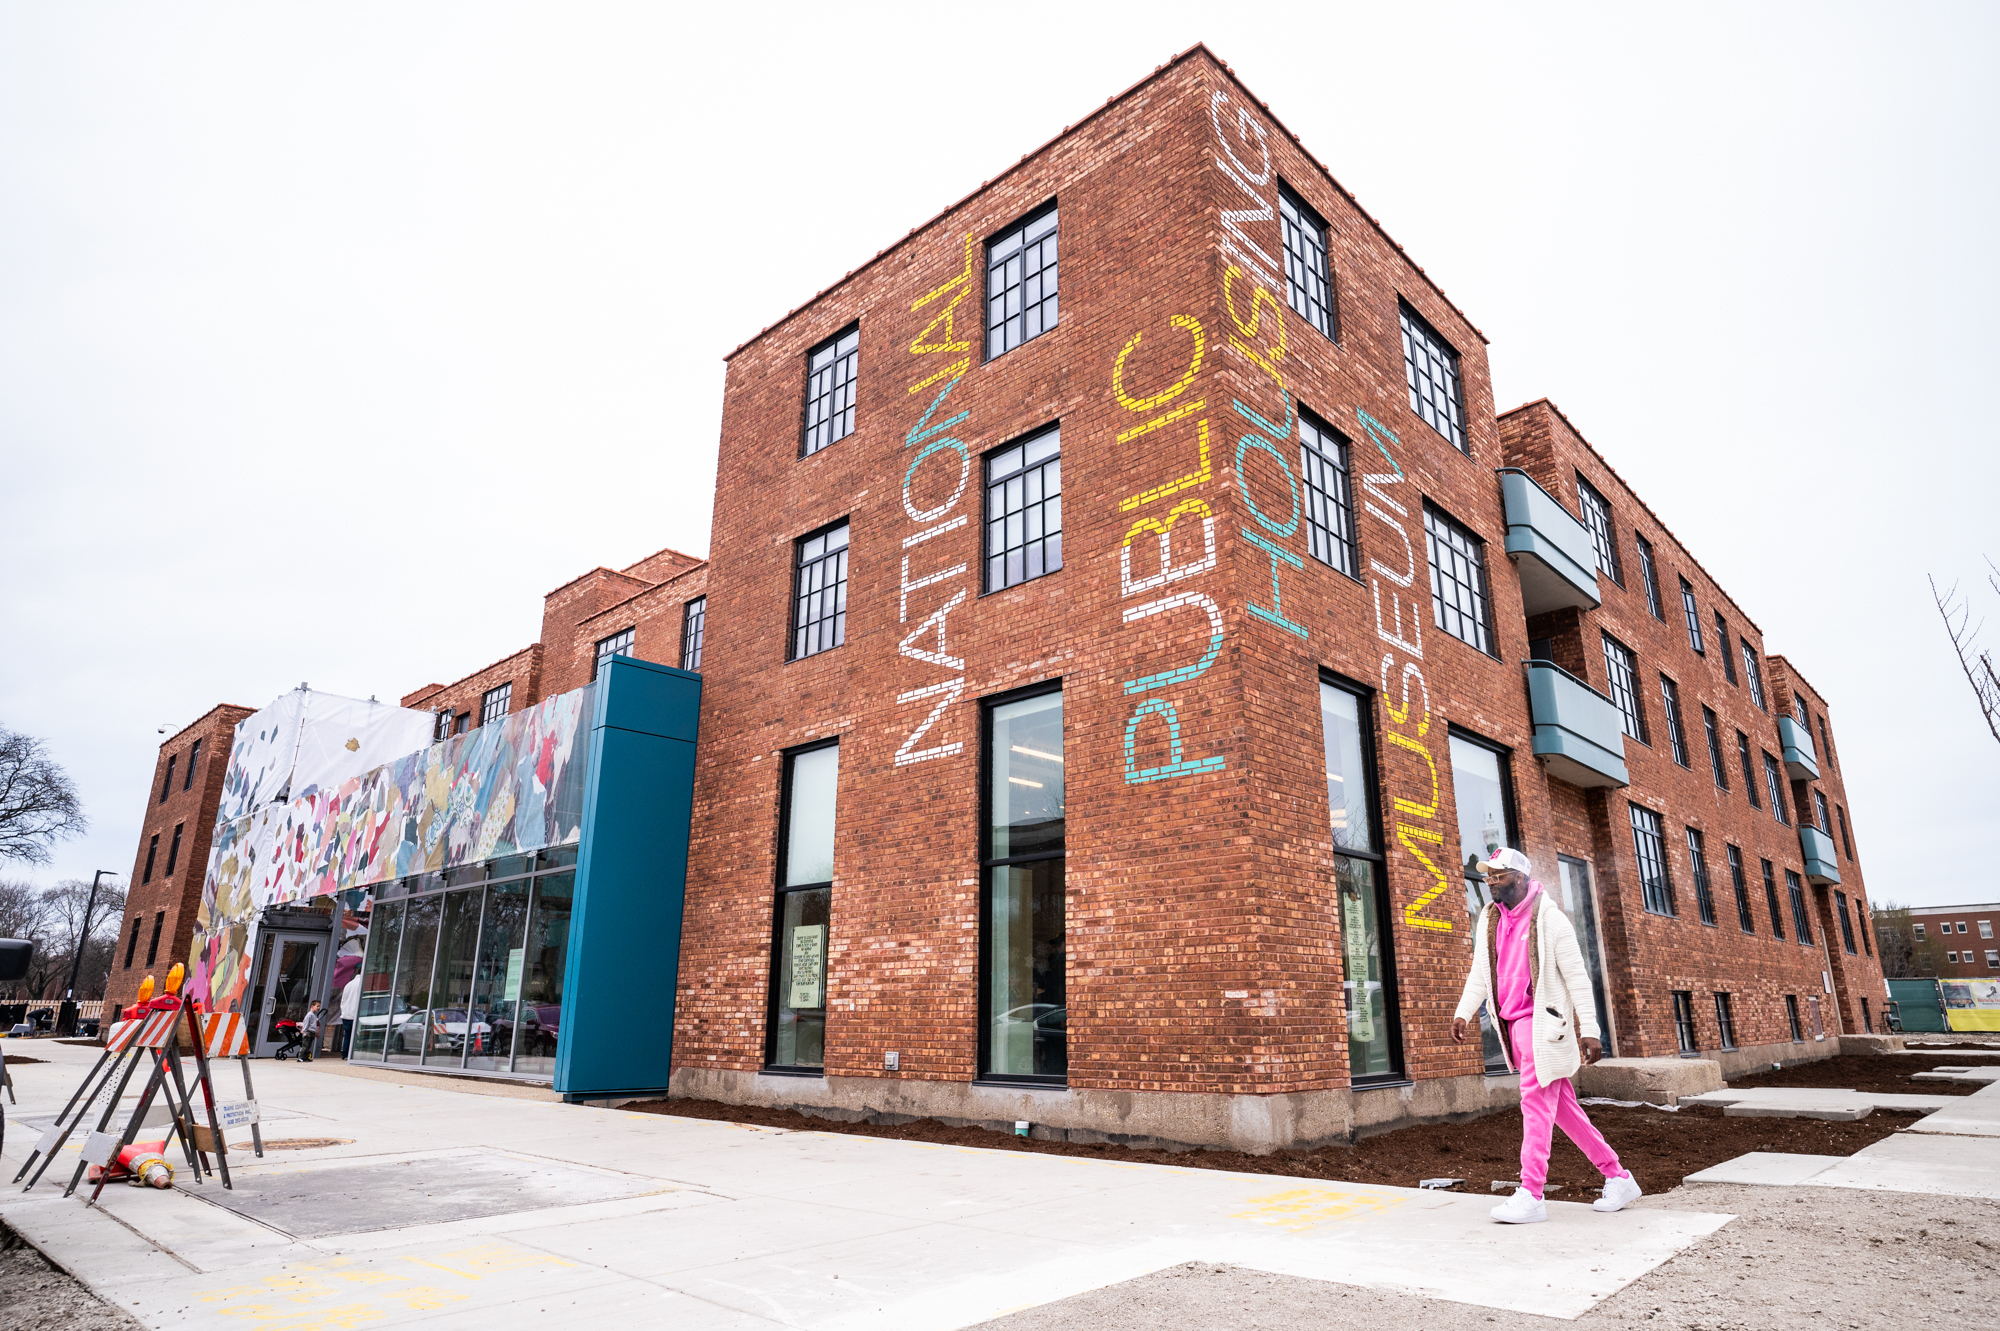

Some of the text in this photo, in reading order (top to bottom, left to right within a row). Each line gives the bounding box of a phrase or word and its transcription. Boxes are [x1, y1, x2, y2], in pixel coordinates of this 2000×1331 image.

[895, 232, 973, 767] NATIONAL
[1112, 313, 1226, 784] PUBLIC
[1211, 90, 1309, 640] HOUSING
[1355, 406, 1453, 934] MUSEUM
